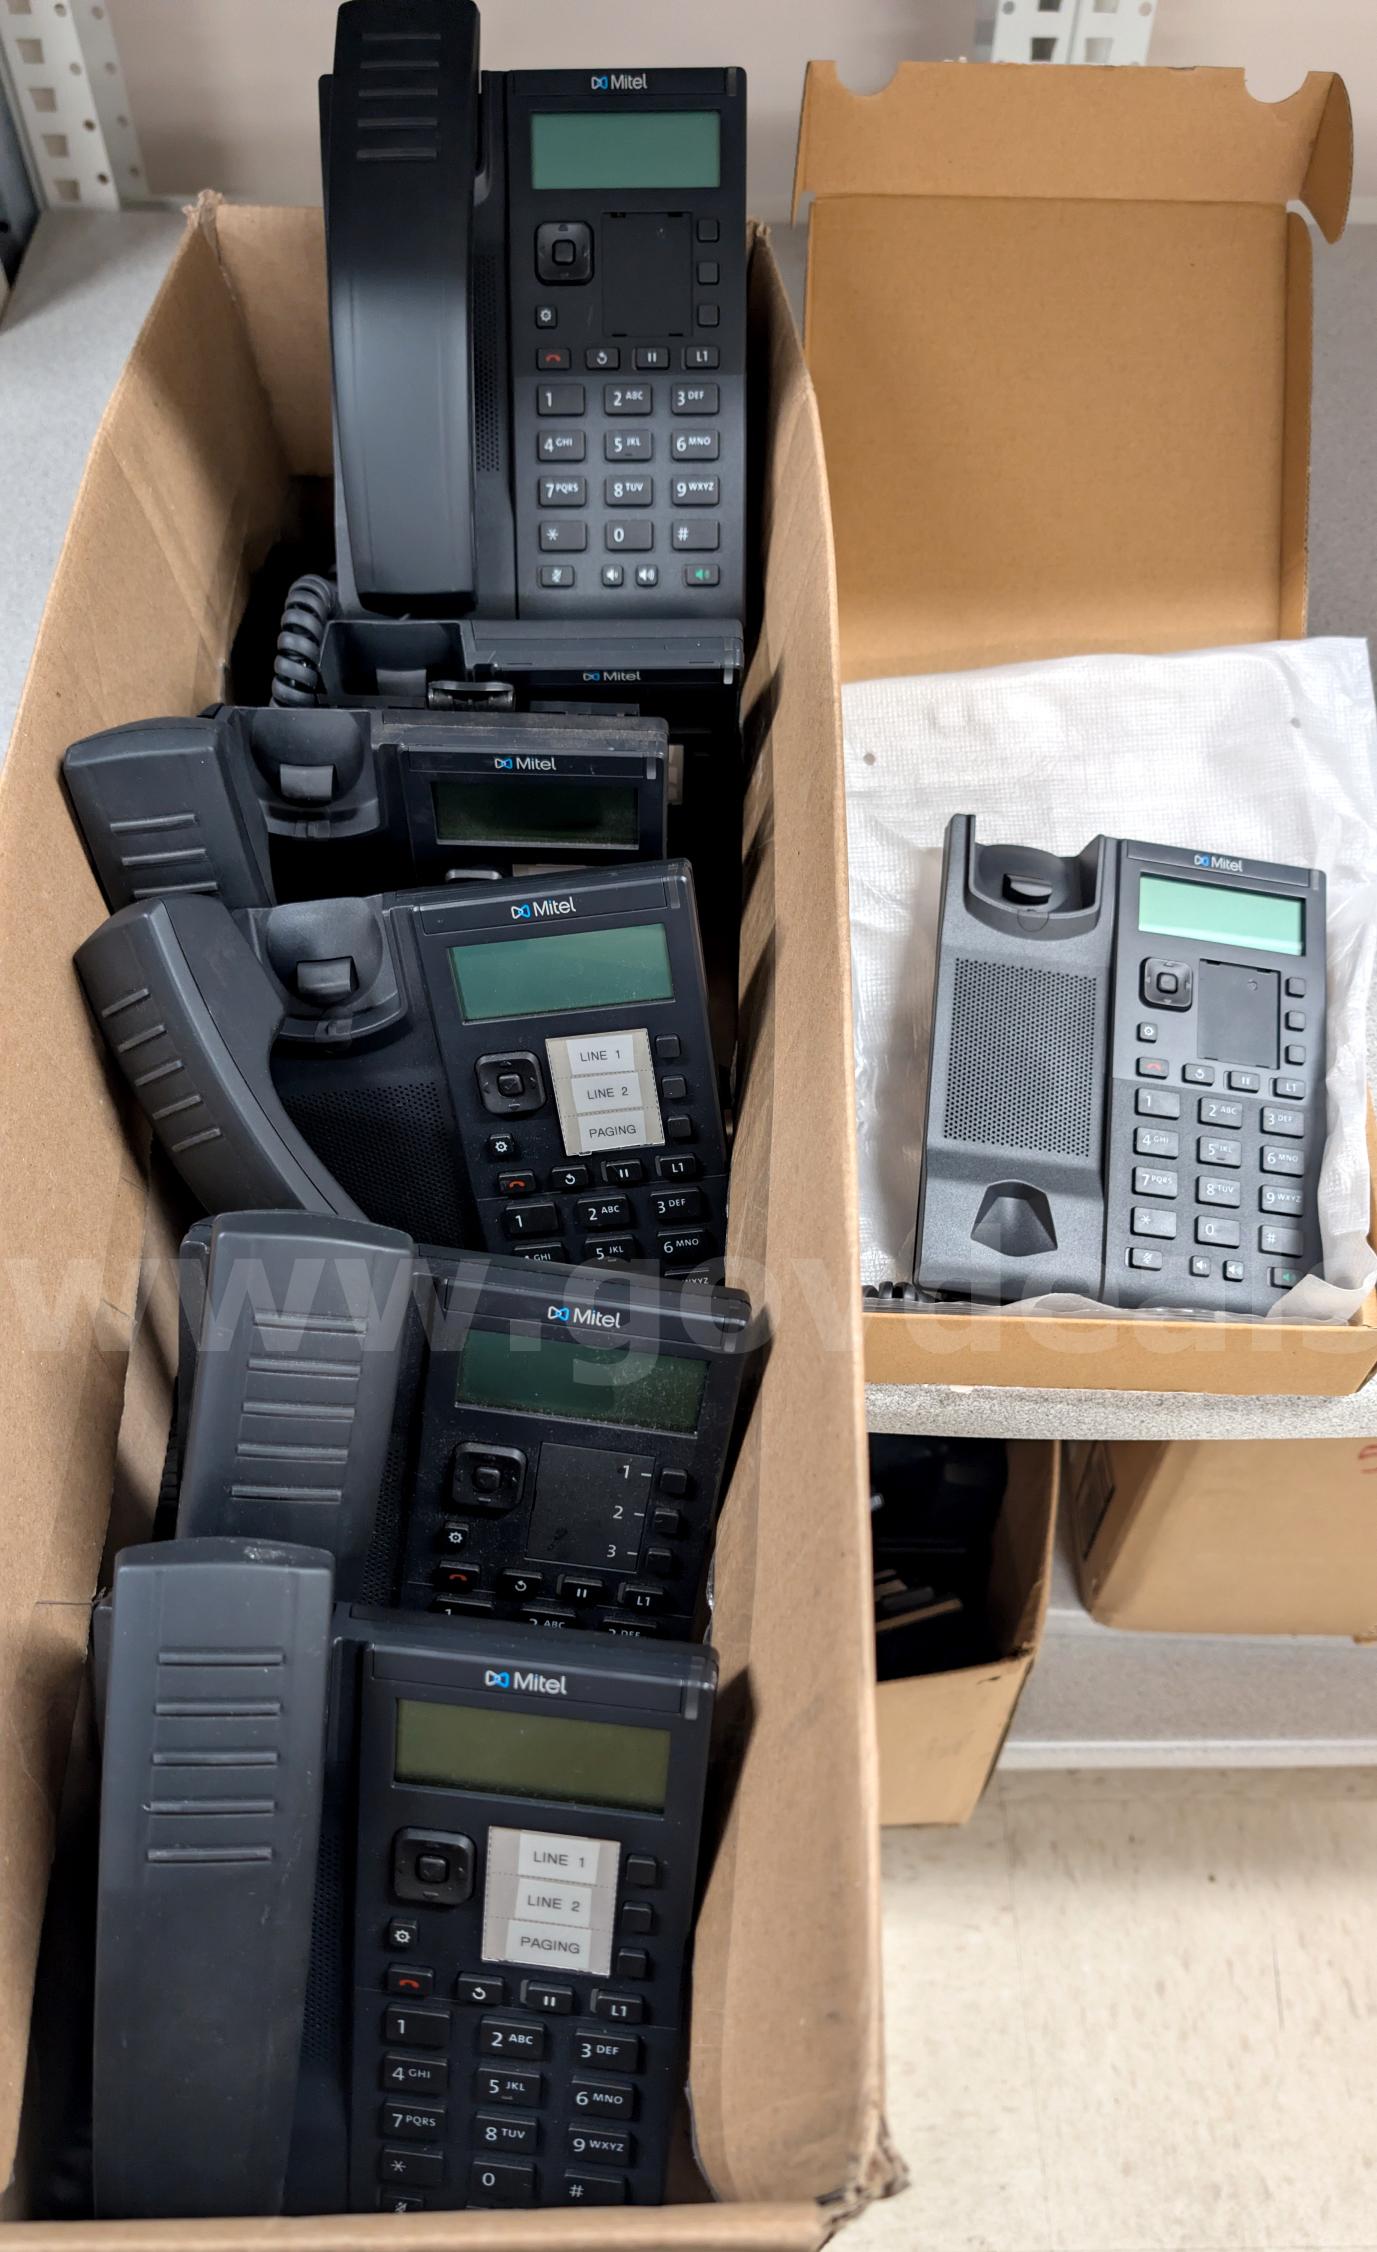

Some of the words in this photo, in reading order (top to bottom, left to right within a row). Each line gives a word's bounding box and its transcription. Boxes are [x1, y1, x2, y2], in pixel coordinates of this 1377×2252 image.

[611, 74, 647, 89] Mitel
[697, 351, 708, 362] L1
[546, 392, 552, 407] 1
[614, 392, 622, 406] 2
[626, 391, 643, 400] ABC
[678, 391, 686, 406] 3
[688, 391, 704, 400] DEF
[544, 438, 553, 452] 4
[556, 438, 573, 447] GHI
[614, 438, 622, 452] 5
[676, 437, 686, 452] 6
[688, 437, 711, 446] MNO
[546, 484, 554, 498] 7
[556, 484, 578, 493] PQRS
[614, 482, 624, 498] 8
[626, 482, 643, 492] TUV
[677, 482, 686, 497] 9
[689, 482, 714, 491] WXYZ
[614, 528, 624, 542] 0
[604, 671, 641, 682] Mitel
[516, 758, 556, 770] Mitel
[1211, 856, 1242, 872] Mitel
[534, 897, 576, 918] Mitel
[580, 1050, 608, 1062] LINE
[616, 1050, 621, 1060] 1
[587, 1088, 614, 1100] LINE
[621, 1087, 628, 1096] 2
[1286, 1083, 1296, 1092] L1
[1145, 1096, 1151, 1106] 1
[1208, 1105, 1216, 1117] 2
[1220, 1106, 1237, 1115] ABC
[1268, 1114, 1276, 1125] 3
[588, 1124, 637, 1138] PAGING
[1142, 1134, 1151, 1146] 4
[1154, 1136, 1169, 1144] GHI
[1208, 1144, 1216, 1155] 5
[1268, 1152, 1276, 1164] 6
[1279, 1154, 1298, 1162] MNO
[672, 1162, 684, 1172] L1
[1142, 1174, 1150, 1186] 7
[1152, 1175, 1172, 1184] PQRS
[1206, 1184, 1215, 1196] 8
[1218, 1185, 1234, 1194] TUV
[1266, 1192, 1275, 1204] 9
[1278, 1194, 1301, 1202] WXYZ
[588, 1208, 598, 1221] 2
[601, 1205, 620, 1214] ABC
[658, 1202, 666, 1214] 3
[669, 1199, 686, 1208] DEF
[515, 1215, 522, 1228] 1
[1206, 1224, 1215, 1236] 0
[596, 1248, 604, 1260] 5
[609, 1246, 624, 1254] JKL
[664, 1242, 673, 1254] 6
[676, 1238, 699, 1248] MNO
[573, 1308, 621, 1328] Mitel
[622, 1465, 630, 1478] 1
[613, 1506, 624, 1519] 2
[606, 1545, 616, 1558] 3
[636, 1596, 651, 1606] L1
[514, 1671, 567, 1695] Mitel
[533, 1852, 568, 1866] LINE
[579, 1858, 584, 1868] 1
[527, 1894, 562, 1910] LINE
[571, 1901, 580, 1912] 2
[520, 1936, 580, 1954] PAGING
[612, 2004, 627, 2016] L1
[398, 2020, 405, 2034] 1
[491, 2032, 502, 2047] 2
[508, 2034, 534, 2045] ABC
[580, 2044, 592, 2058] 3
[596, 2044, 620, 2056] DEF
[392, 2067, 404, 2080] 4
[408, 2068, 430, 2079] GHI
[489, 2079, 499, 2094] 5
[506, 2081, 525, 2092] JKL
[576, 2091, 588, 2106] 6
[593, 2093, 623, 2104] MNO
[392, 2114, 403, 2128] 7
[406, 2114, 436, 2126] PQRS
[485, 2126, 498, 2141] 8
[502, 2128, 526, 2140] TUV
[573, 2138, 586, 2152] 9
[590, 2140, 624, 2152] WXYZ
[482, 2172, 495, 2186] 0
